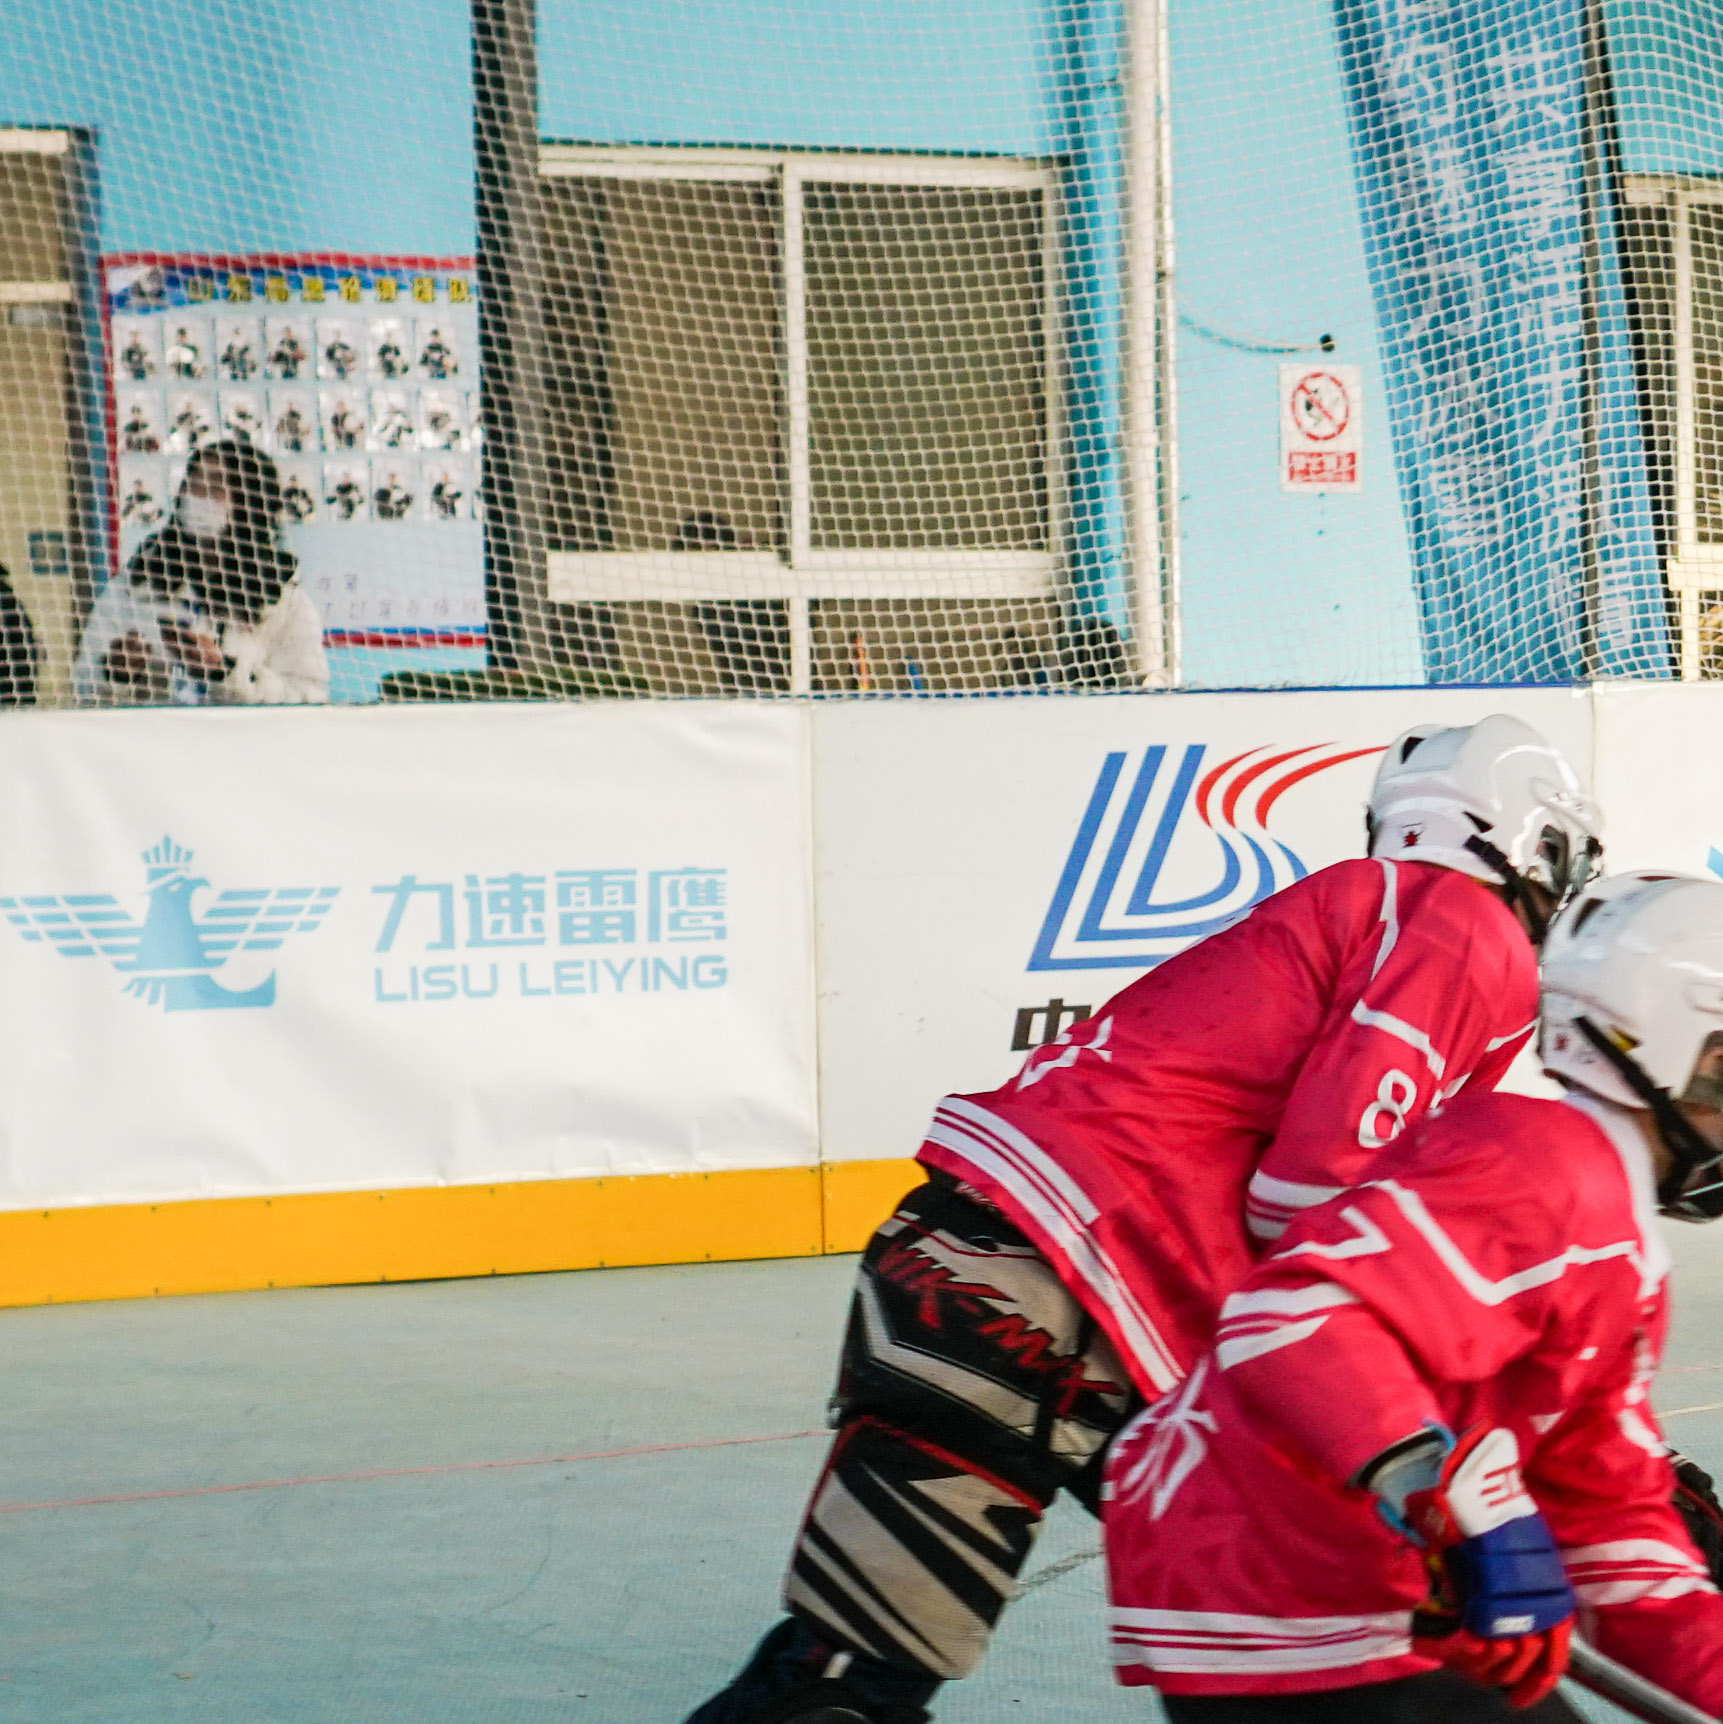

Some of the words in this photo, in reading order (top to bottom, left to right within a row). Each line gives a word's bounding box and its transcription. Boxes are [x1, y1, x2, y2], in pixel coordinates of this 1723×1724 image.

[370, 866, 730, 954] 力速雷鹰
[374, 963, 501, 1003] LISU
[519, 954, 730, 996] LEIYING
[1359, 1068, 1418, 1148] 8
